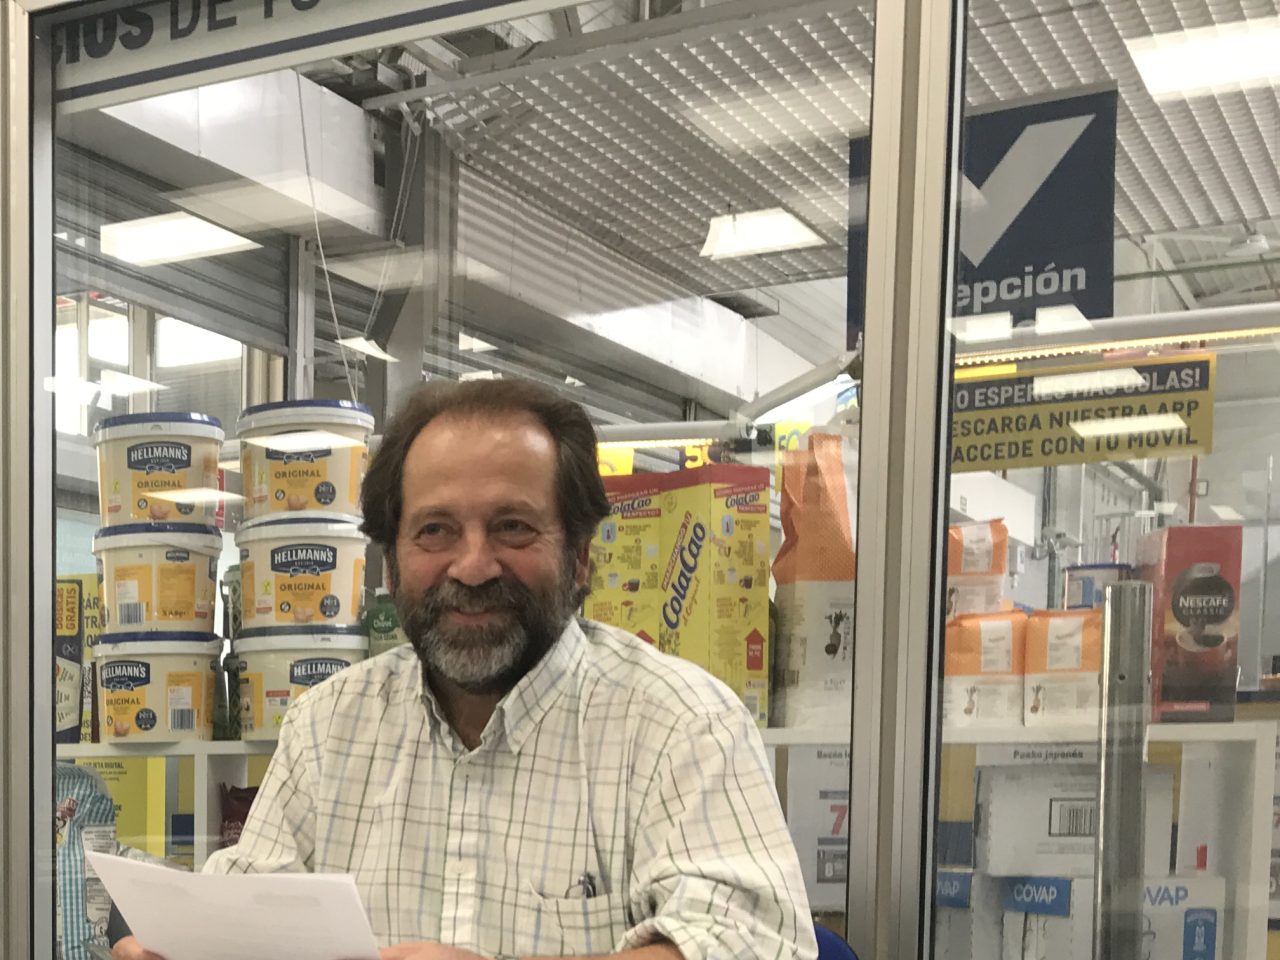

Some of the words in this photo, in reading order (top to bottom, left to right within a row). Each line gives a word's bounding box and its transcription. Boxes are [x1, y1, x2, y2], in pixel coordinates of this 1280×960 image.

[170, 0, 237, 40] DE
[956, 262, 1086, 313] epción
[131, 447, 188, 462] HELLMANN'S
[952, 440, 1033, 463] ACCEDE
[1041, 437, 1084, 456] CON
[137, 479, 184, 489] ORIGINAL
[274, 469, 321, 479] ORIGINAL
[725, 492, 760, 509] ColaCao
[274, 548, 333, 564] HELLMANN'S
[662, 522, 706, 629] ColaCao
[280, 583, 327, 592] ORIGINAL
[65, 588, 76, 630] GRATIS
[101, 664, 146, 680] HELLMANN'S
[830, 804, 848, 835] 7
[1014, 883, 1057, 904] COVAP
[1143, 886, 1188, 906] VAP
